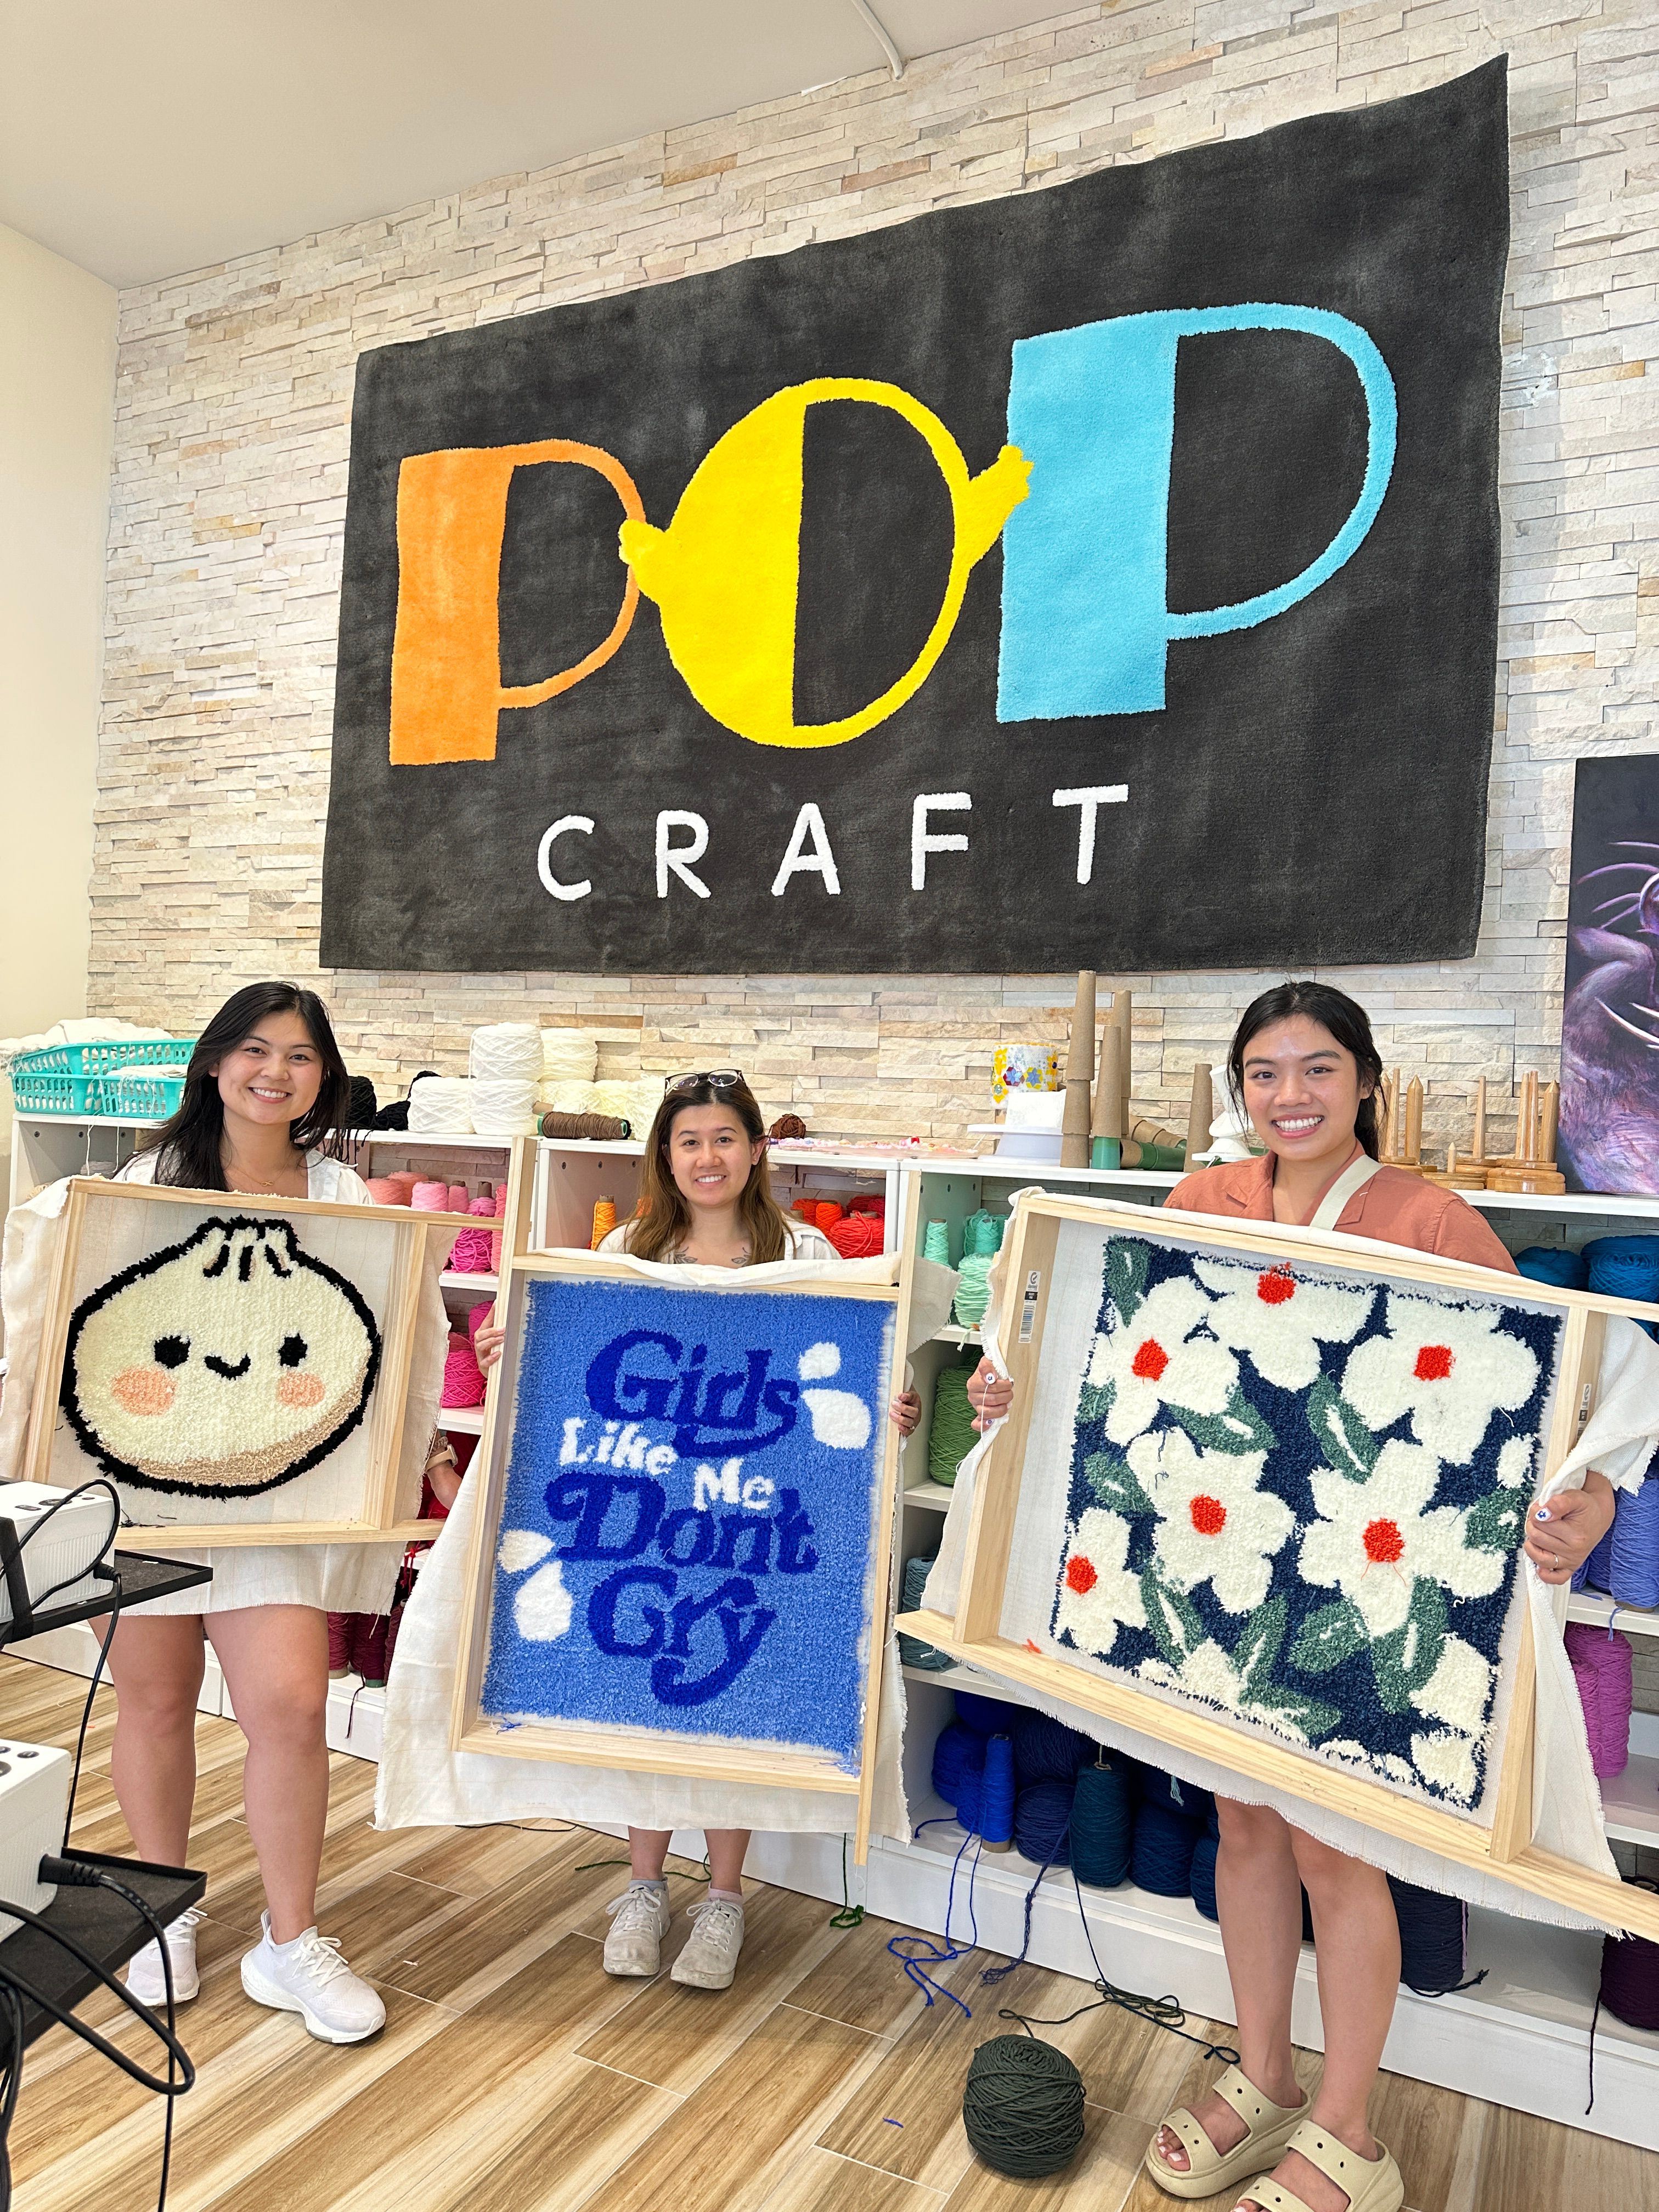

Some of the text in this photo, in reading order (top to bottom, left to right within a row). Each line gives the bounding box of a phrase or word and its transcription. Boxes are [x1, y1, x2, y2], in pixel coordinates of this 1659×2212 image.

[389, 303, 1398, 766] POP
[537, 784, 1129, 901] CRAFT
[585, 1328, 799, 1459] Girls
[559, 1417, 775, 1511] Like Me
[586, 1565, 777, 1708] Cry
